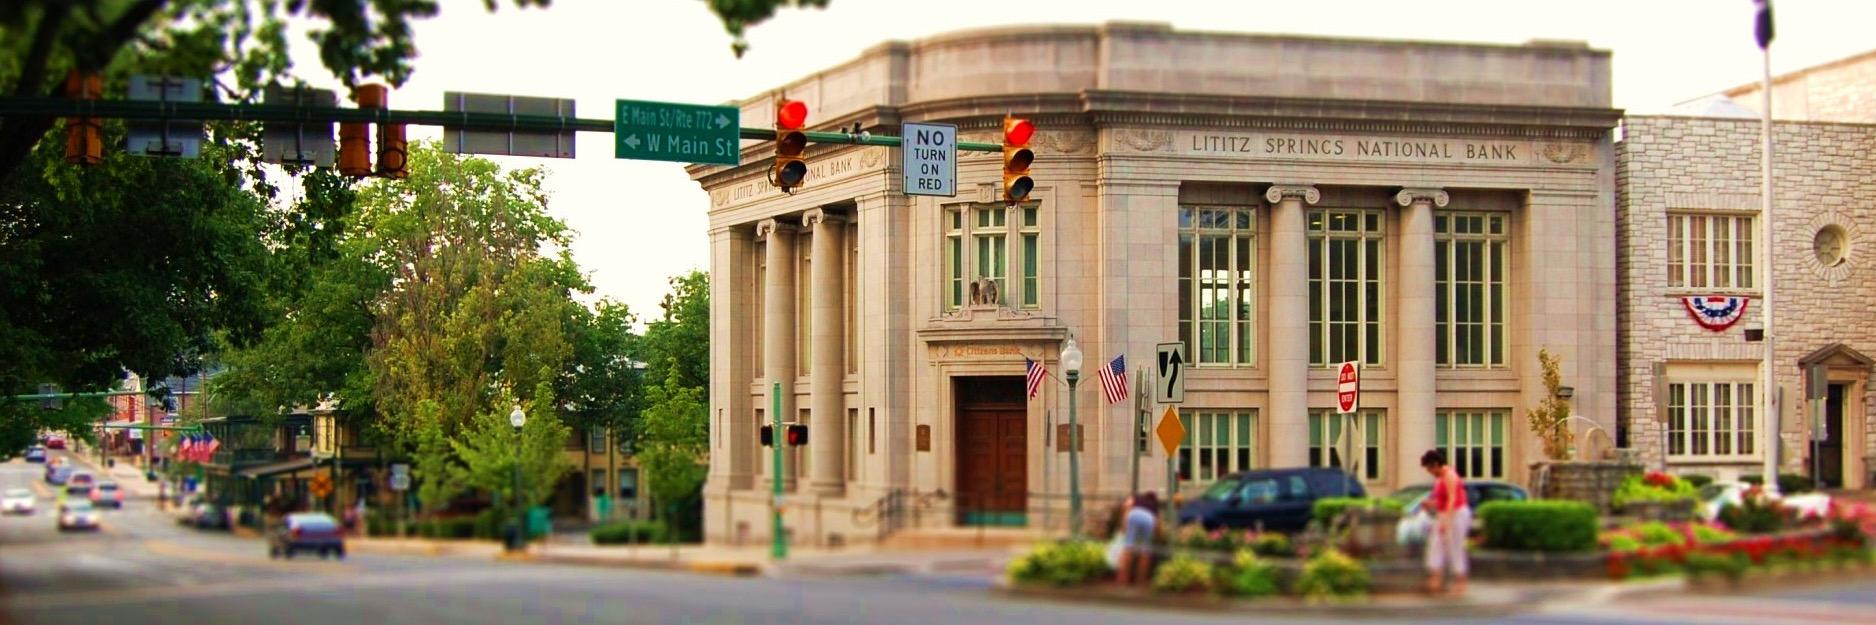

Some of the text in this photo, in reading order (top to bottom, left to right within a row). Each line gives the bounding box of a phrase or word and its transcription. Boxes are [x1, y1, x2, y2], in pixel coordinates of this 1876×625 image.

[622, 105, 713, 130] E Main St/Rte 772
[647, 134, 732, 157] W Main St
[917, 129, 944, 146] NO
[914, 148, 946, 161] TURN
[1192, 135, 1250, 153] LITITZ
[1357, 140, 1452, 158] NATIONAL
[1466, 144, 1517, 160] BANK
[831, 158, 853, 176] BANK
[921, 164, 938, 175] ON
[919, 178, 942, 190] RED
